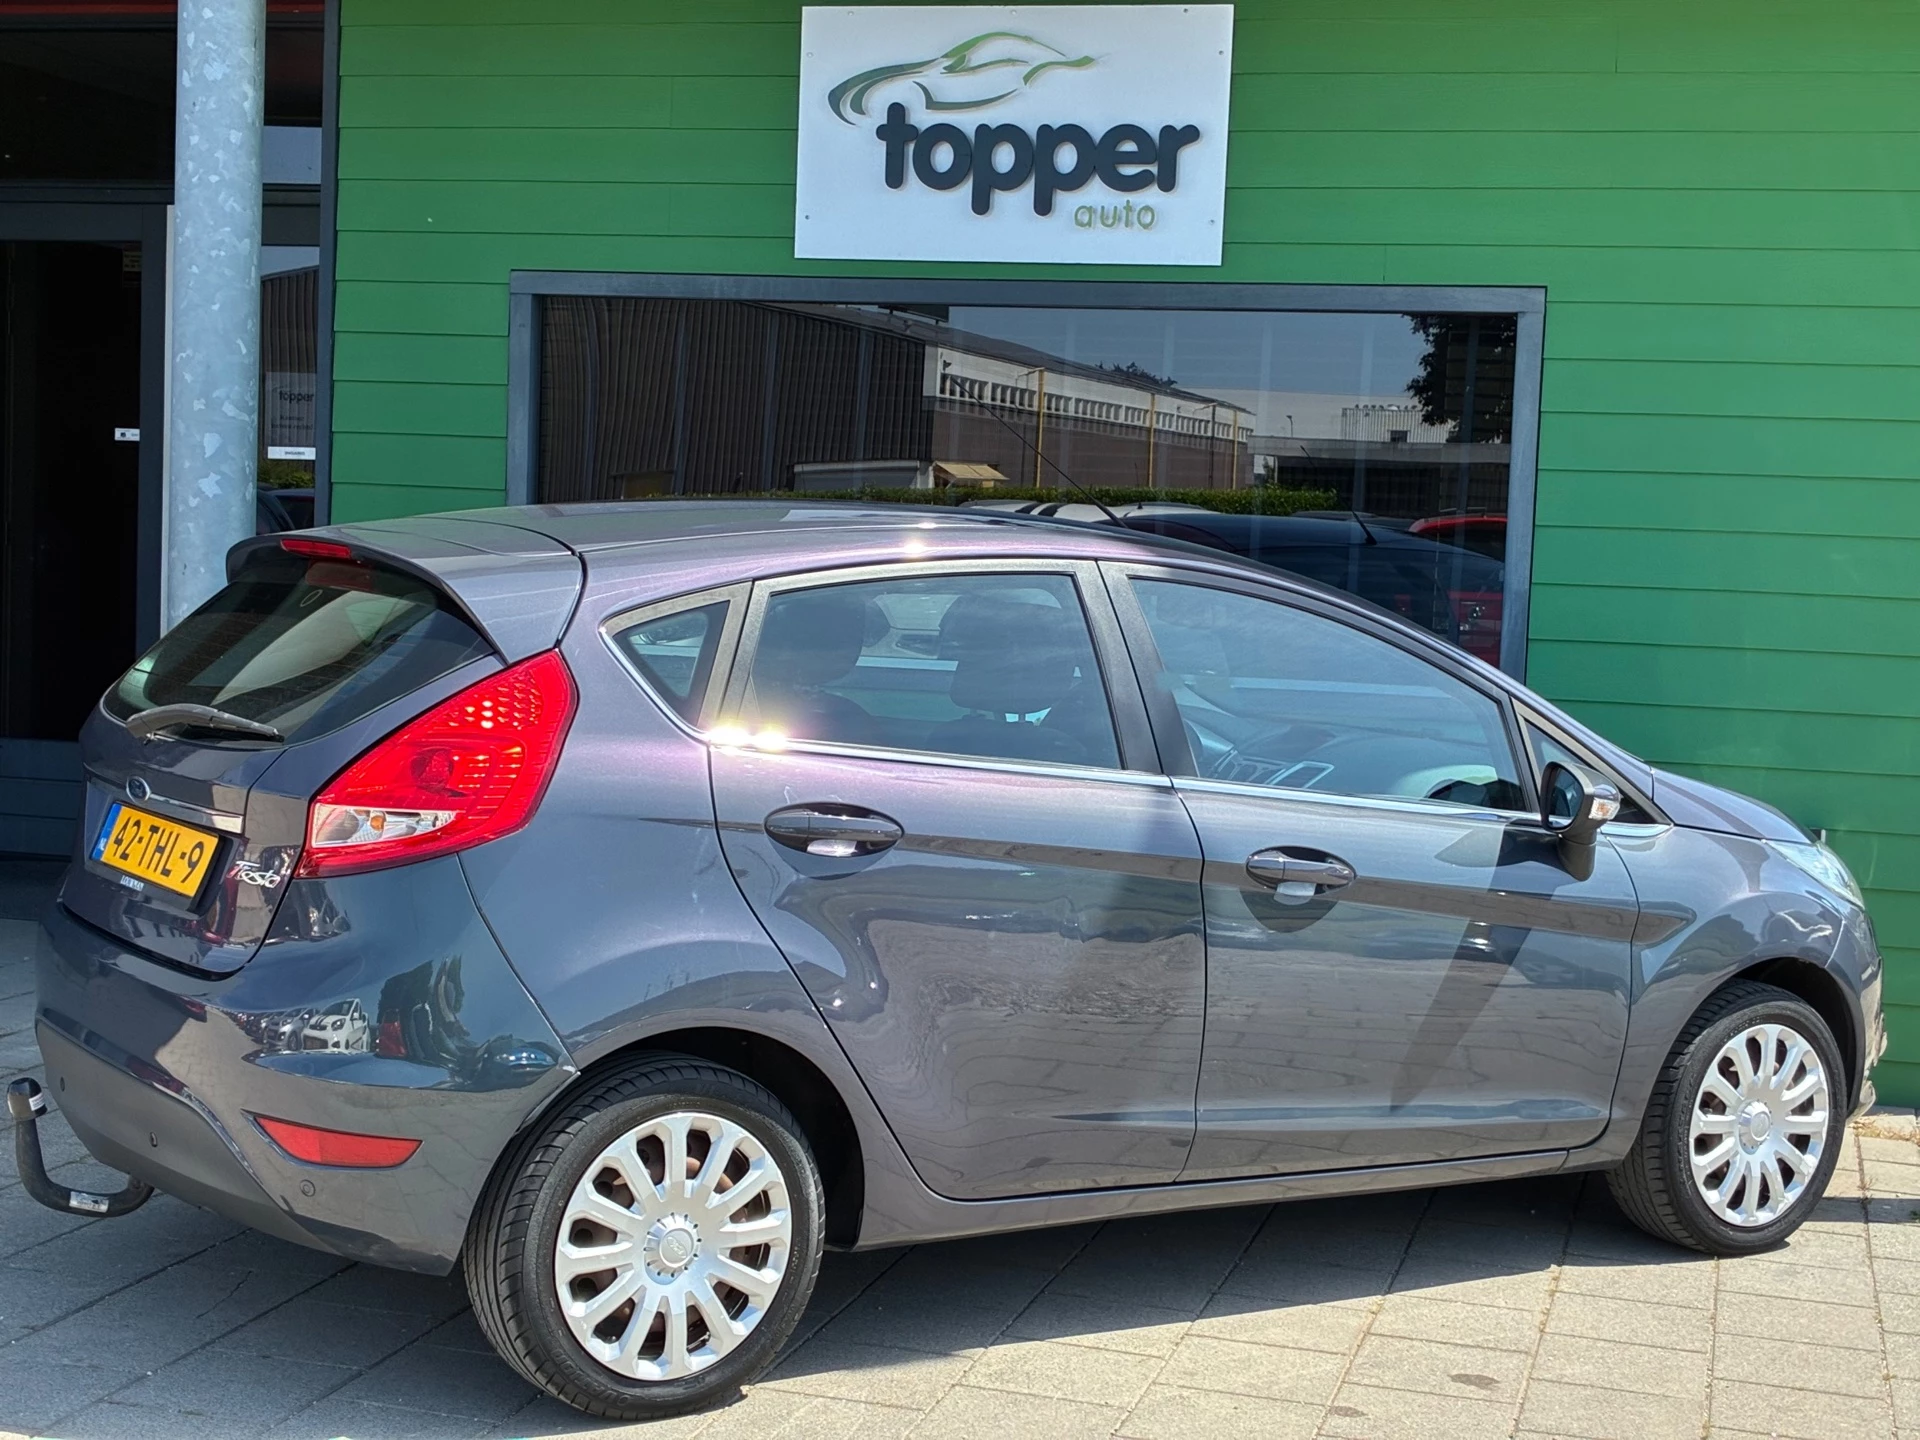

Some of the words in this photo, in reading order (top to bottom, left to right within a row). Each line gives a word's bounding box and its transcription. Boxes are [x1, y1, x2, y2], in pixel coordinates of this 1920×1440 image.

[876, 102, 1200, 216] topper
[1074, 200, 1156, 230] auto
[112, 816, 205, 884] 42-THL-9
[226, 861, 281, 888] Fiesta
